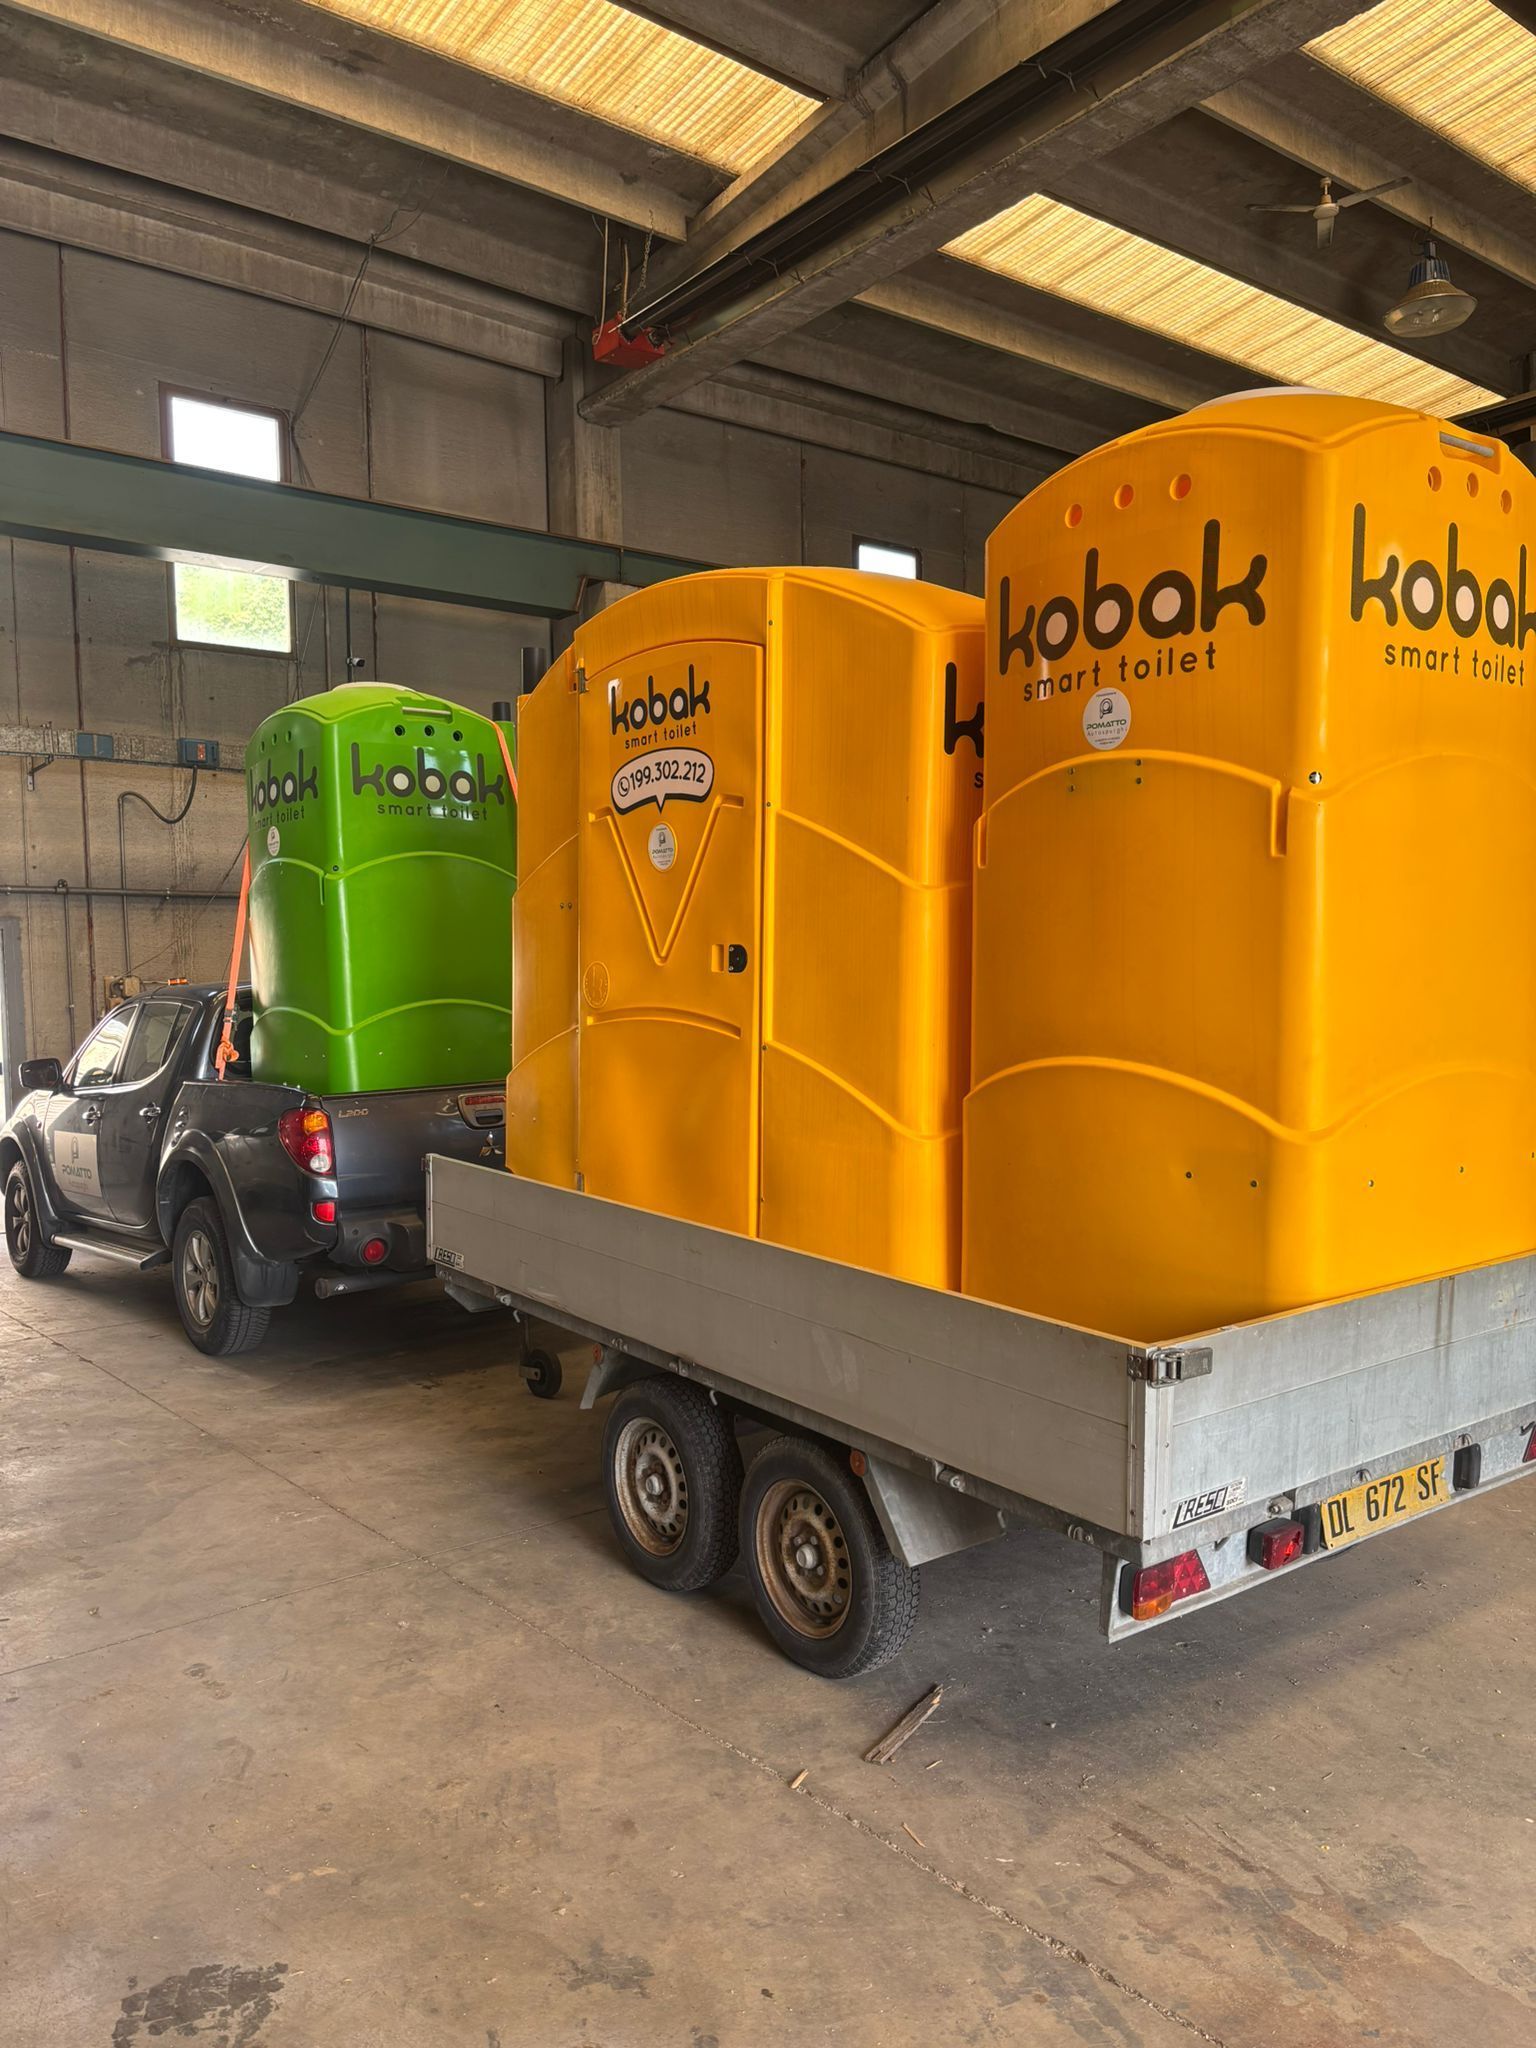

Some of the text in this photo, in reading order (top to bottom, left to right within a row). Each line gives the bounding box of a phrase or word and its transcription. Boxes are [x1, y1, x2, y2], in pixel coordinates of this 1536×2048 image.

[999, 519, 1267, 675] kobak
[1023, 641, 1216, 702] smart toilet
[1384, 644, 1525, 687] smart toilet
[611, 664, 711, 736] kobak
[1086, 719, 1127, 730] POMATTO
[624, 721, 697, 749] smart toilet
[250, 748, 318, 817] kobak
[351, 742, 505, 805] kobak
[629, 760, 706, 790] 199.302.212
[276, 806, 305, 823] toilet
[377, 804, 487, 820] smart toilet
[1327, 1461, 1440, 1538] DL 672 SF
